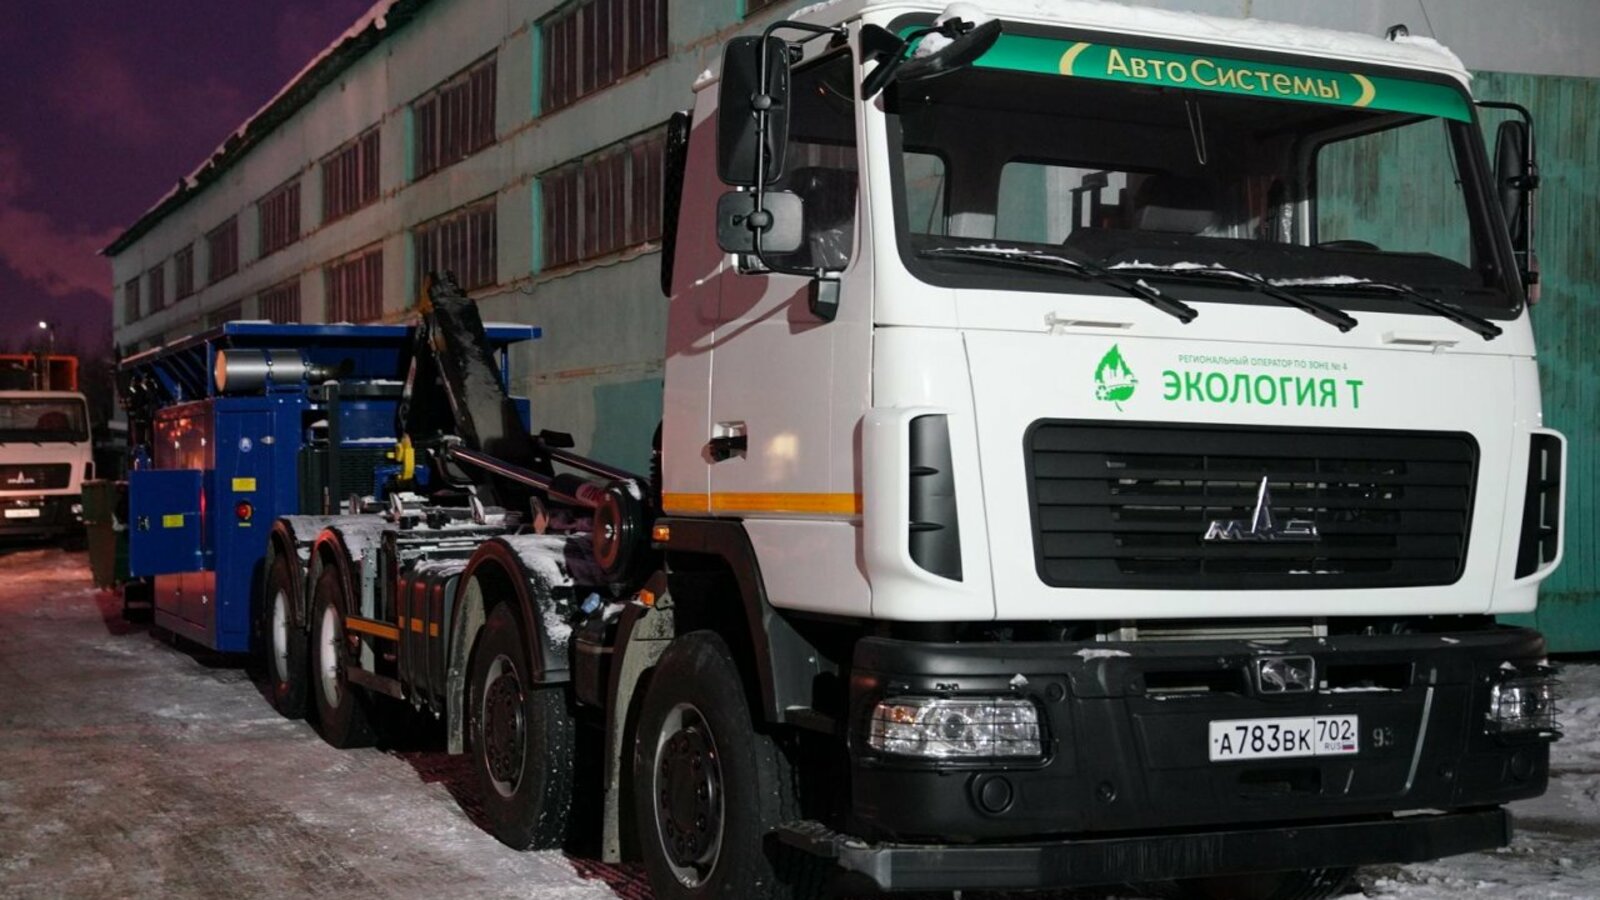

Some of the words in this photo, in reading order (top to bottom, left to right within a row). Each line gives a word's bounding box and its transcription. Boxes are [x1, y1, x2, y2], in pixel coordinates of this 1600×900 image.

[1250, 357, 1292, 368] ОПЕРАТОР
[1162, 370, 1337, 408] ЭКОЛОГИЯ
[1345, 379, 1364, 409] Т
[1317, 719, 1352, 742] 702
[1324, 742, 1341, 750] RUS
